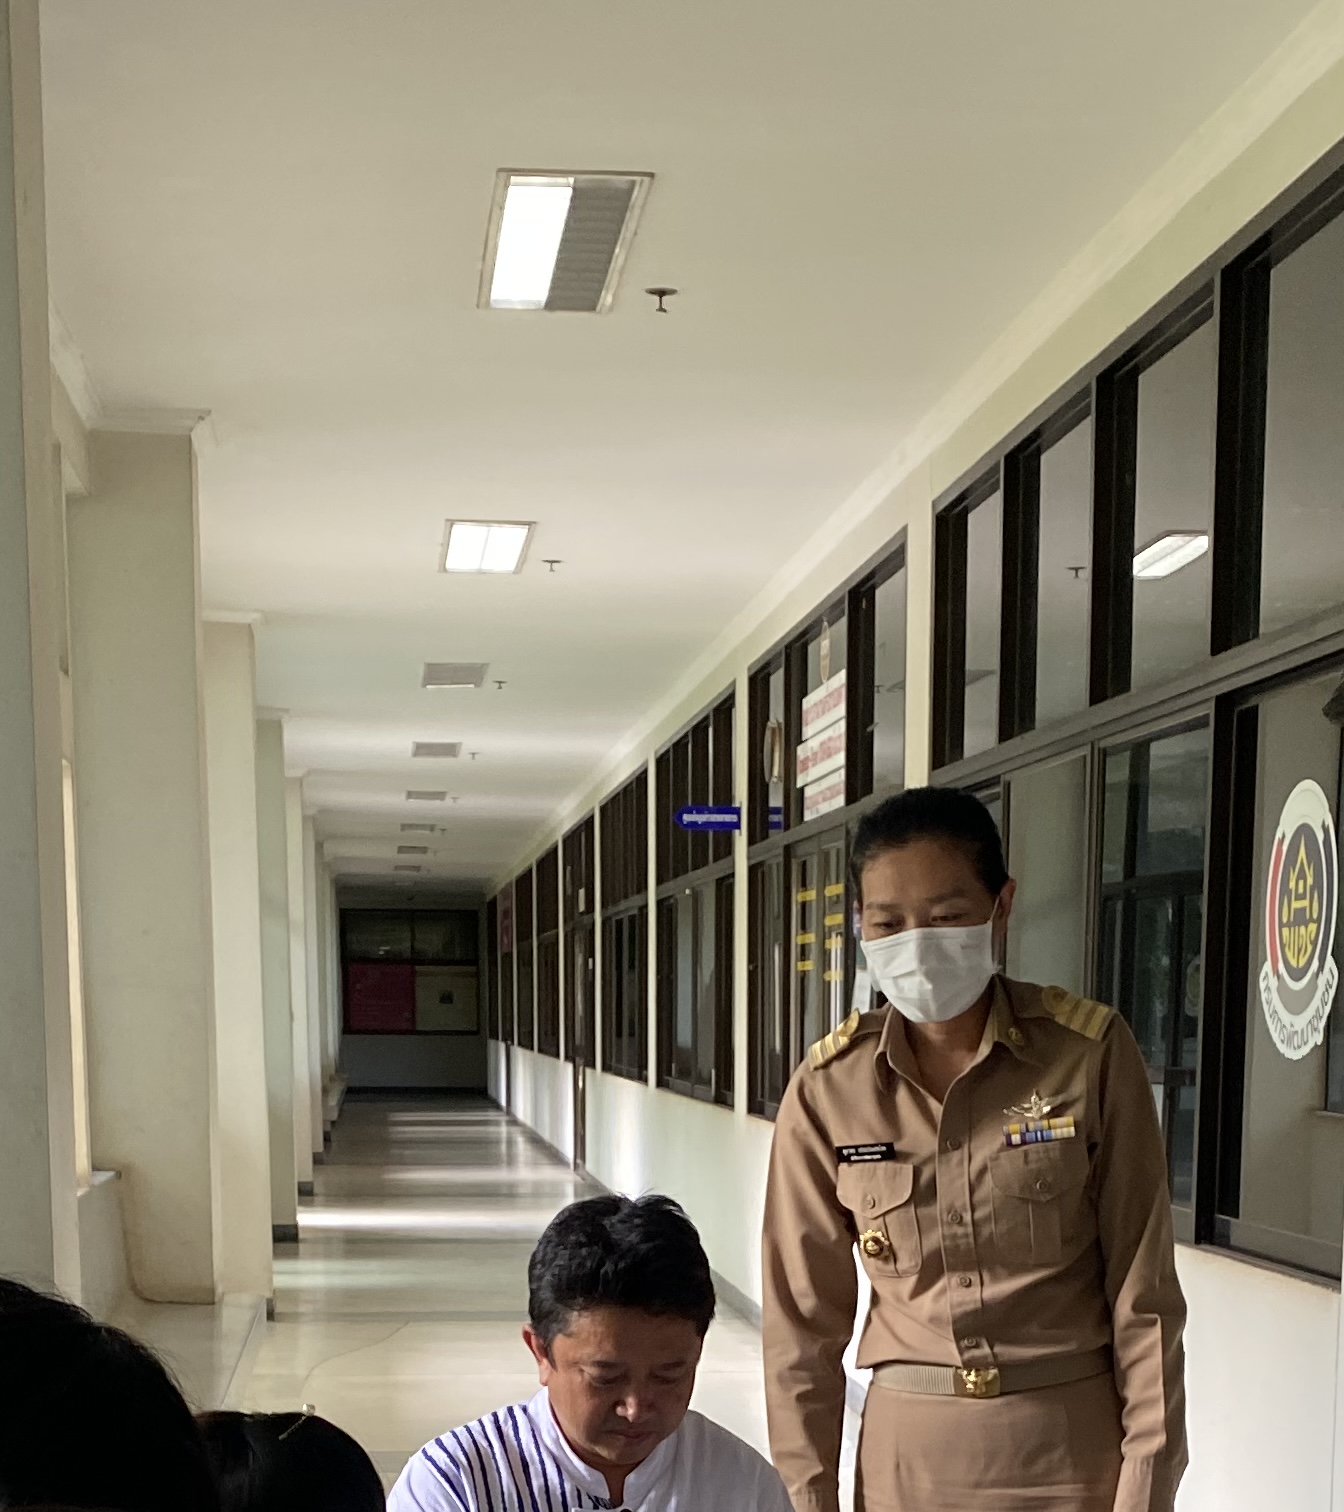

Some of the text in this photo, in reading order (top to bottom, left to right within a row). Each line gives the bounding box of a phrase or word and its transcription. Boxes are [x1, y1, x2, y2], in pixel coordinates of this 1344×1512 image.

[1262, 967, 1336, 1052] กรมการพัฒนาชุมชน
